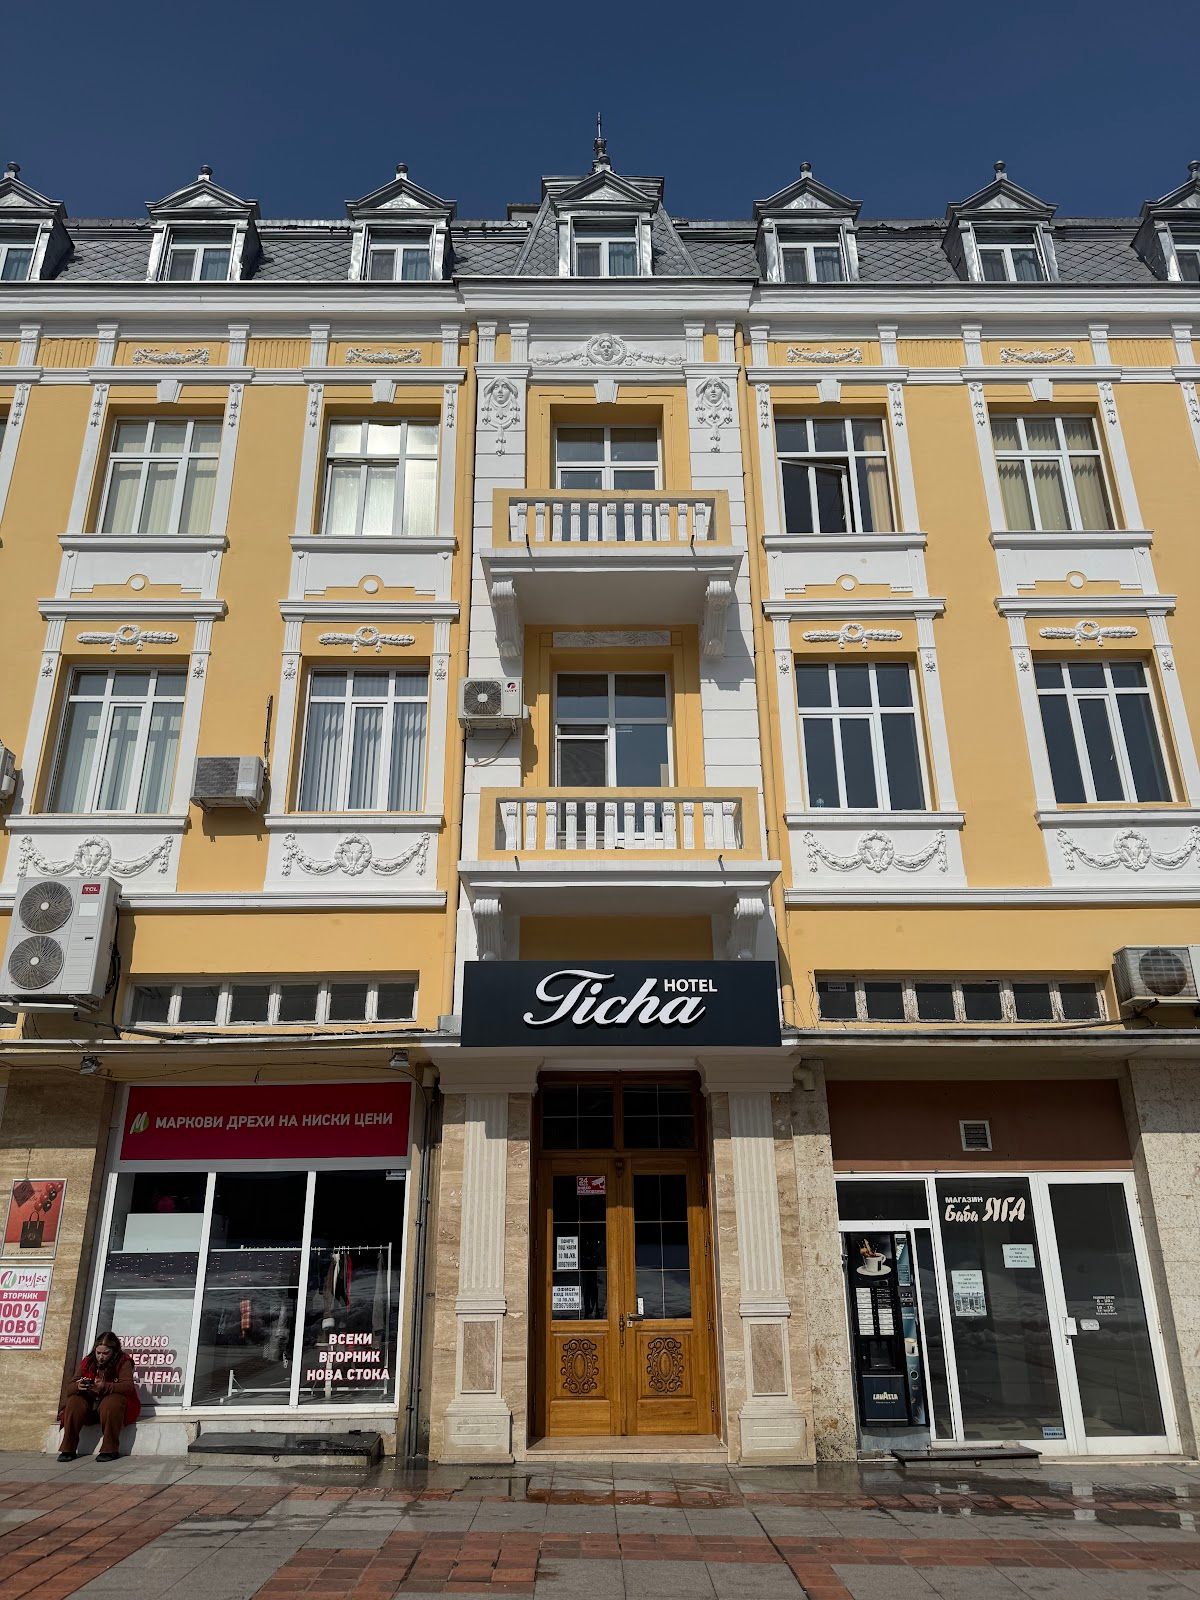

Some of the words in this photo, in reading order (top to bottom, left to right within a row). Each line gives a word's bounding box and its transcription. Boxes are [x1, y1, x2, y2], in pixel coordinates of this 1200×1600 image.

[664, 979, 718, 993] HOTEL
[523, 969, 706, 1025] Ticha
[155, 1116, 224, 1129] МАРКОВИ
[226, 1115, 275, 1130] ДРЕХИ
[278, 1114, 299, 1127] НА
[302, 1113, 351, 1127] НИСКИ
[354, 1112, 394, 1127] ЦЕНИ
[18, 1272, 48, 1288] pulse
[3, 1292, 38, 1300] ВТОРНИК
[328, 1333, 373, 1345] ВСЕКИ
[130, 1353, 175, 1366] ЕСТВО
[318, 1351, 381, 1363] ВТОРНИК
[144, 1371, 181, 1385] ЦЕНА
[306, 1369, 343, 1381] НОВА
[346, 1368, 390, 1380] СТОКА
